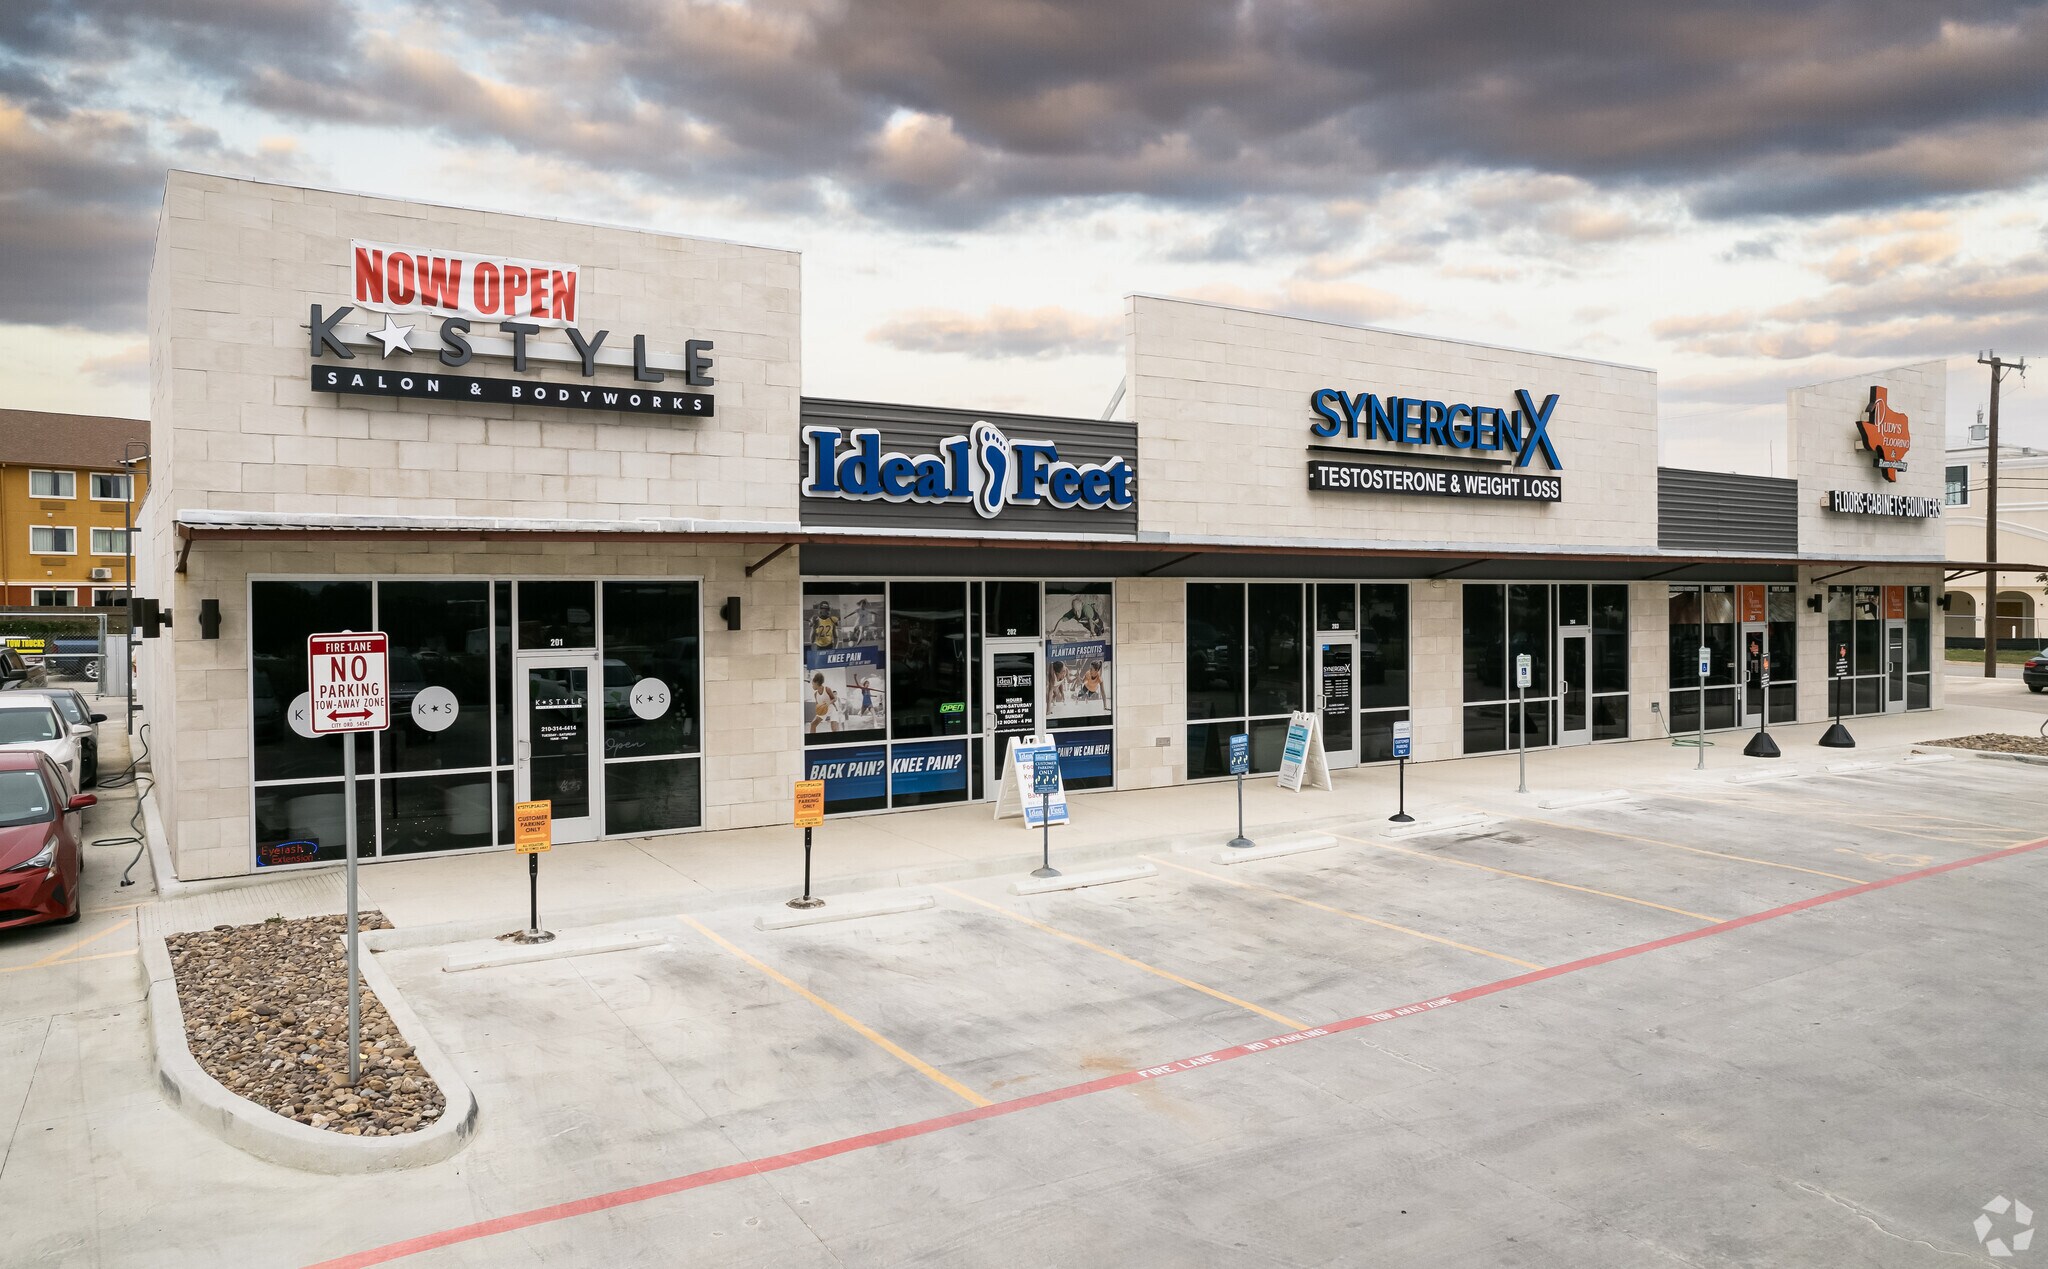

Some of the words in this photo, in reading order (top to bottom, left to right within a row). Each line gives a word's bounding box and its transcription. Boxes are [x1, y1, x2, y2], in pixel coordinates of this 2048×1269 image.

[355, 247, 462, 310] NOW
[473, 261, 577, 322] OPEN
[327, 371, 439, 392] SALON
[470, 383, 482, 396] &
[512, 385, 702, 411] BODYWORKS
[1310, 388, 1563, 470] SYNERGENX
[804, 428, 973, 500] Ideal
[1010, 441, 1133, 508] Feet
[1317, 465, 1446, 493] TESTOSTERONE
[1450, 473, 1461, 493] &
[1464, 475, 1521, 497] WEIGHT
[1523, 478, 1559, 499] LOSS
[818, 624, 831, 638] 22
[6, 639, 20, 648] TOW
[21, 639, 46, 648] TRUCKS
[326, 643, 345, 653] FIRE
[347, 641, 372, 652] LANE
[550, 638, 563, 647] 201
[827, 653, 845, 664] KNEE
[846, 652, 862, 662] PAIN
[1051, 648, 1075, 657] PLANTAR
[331, 655, 367, 682] NO
[320, 682, 379, 698] PARKING
[316, 699, 360, 710] TOW-AWAY
[364, 697, 384, 708] ZONE
[635, 694, 643, 704] K
[658, 693, 665, 703] S
[295, 709, 303, 721] K
[418, 704, 427, 714] K
[444, 703, 452, 714] S
[941, 704, 964, 712] OPEN
[605, 738, 646, 756] Open
[1073, 745, 1083, 757] WE
[1083, 745, 1094, 756] CAN
[1095, 743, 1110, 755] HELP!
[810, 763, 845, 780] BACK
[847, 759, 885, 778] PAIN?
[892, 756, 925, 773] KNEE
[926, 754, 962, 771] PAIN?
[261, 845, 303, 856] Eyelash
[271, 855, 313, 864] Extension
[1366, 1011, 1395, 1021] TOW
[1394, 1005, 1425, 1016] AWAY
[1243, 1042, 1268, 1052] NO
[1269, 1028, 1329, 1046] PARKING
[1137, 1065, 1176, 1078] FIRE
[1177, 1054, 1221, 1069] LANE
